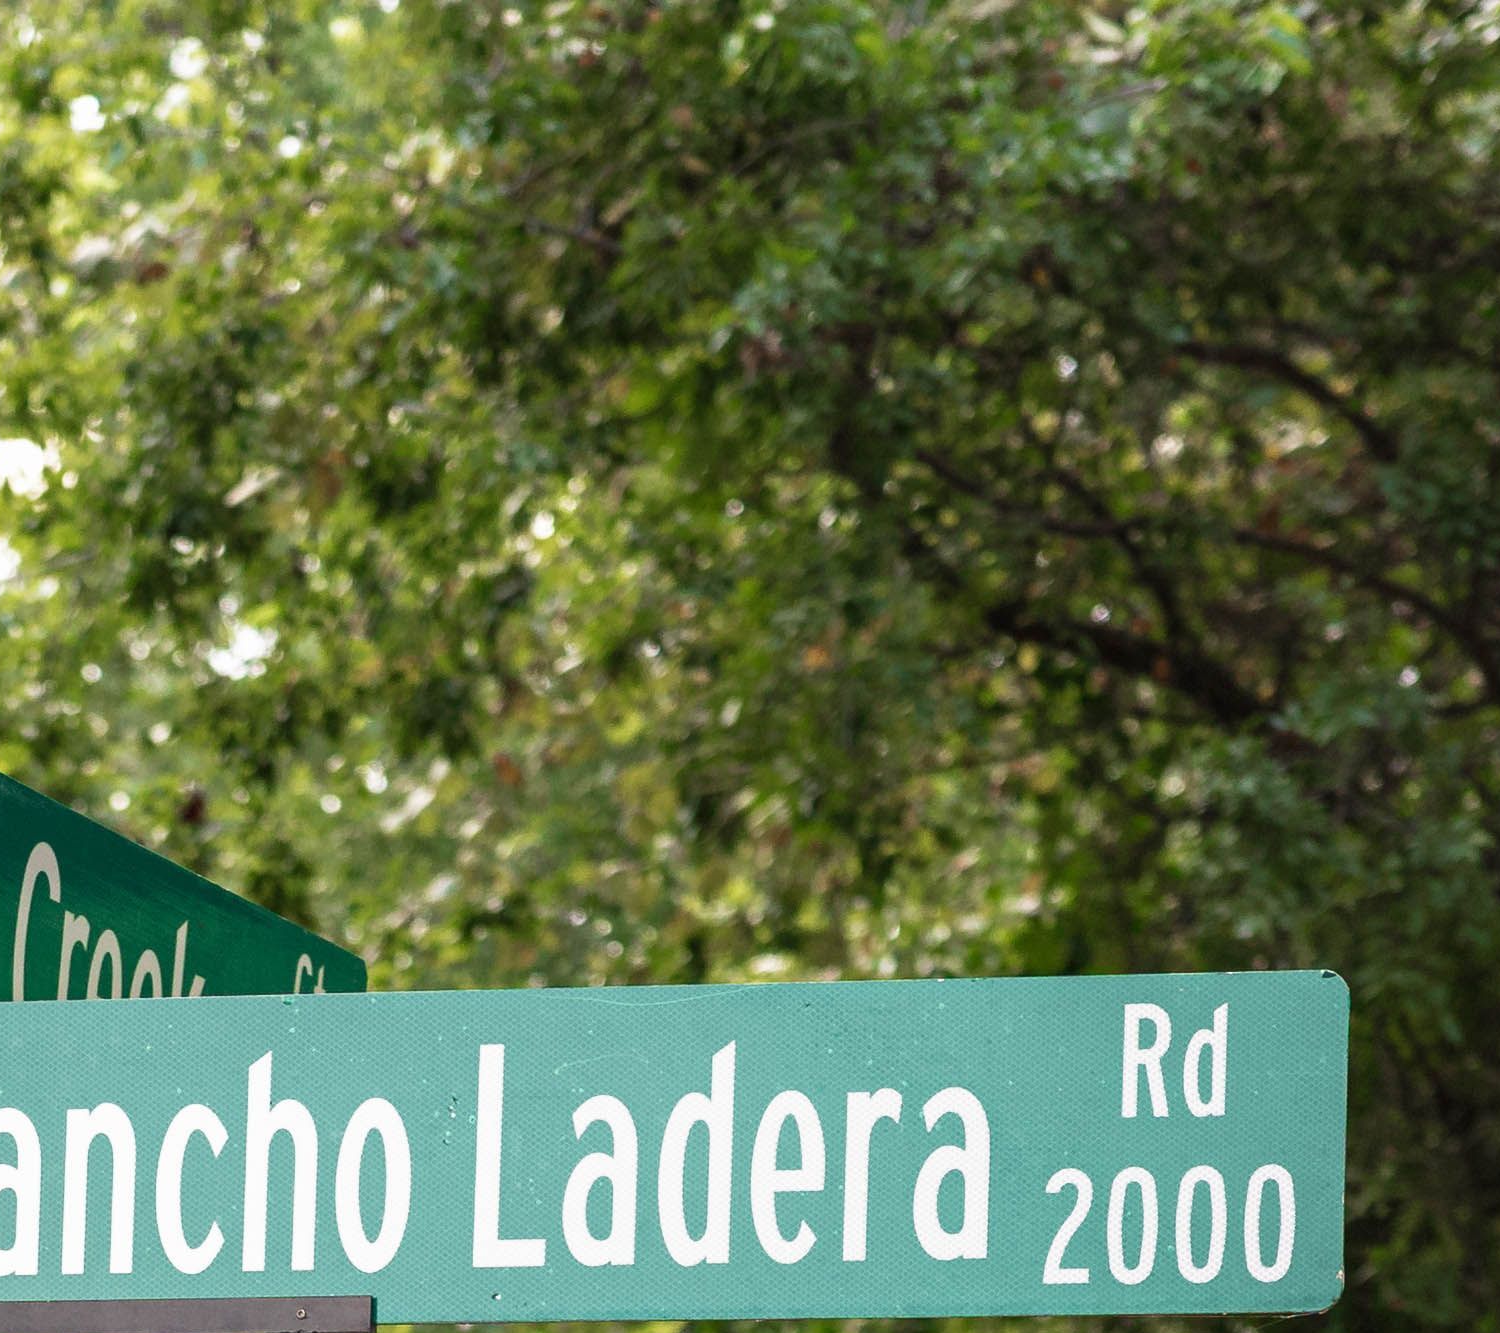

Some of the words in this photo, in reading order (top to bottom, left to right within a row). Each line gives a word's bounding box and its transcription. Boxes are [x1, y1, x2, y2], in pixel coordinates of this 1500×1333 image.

[1120, 1002, 1229, 1119] Rd
[471, 1038, 991, 1269] Ladera
[1041, 1163, 1297, 1286] 2000
